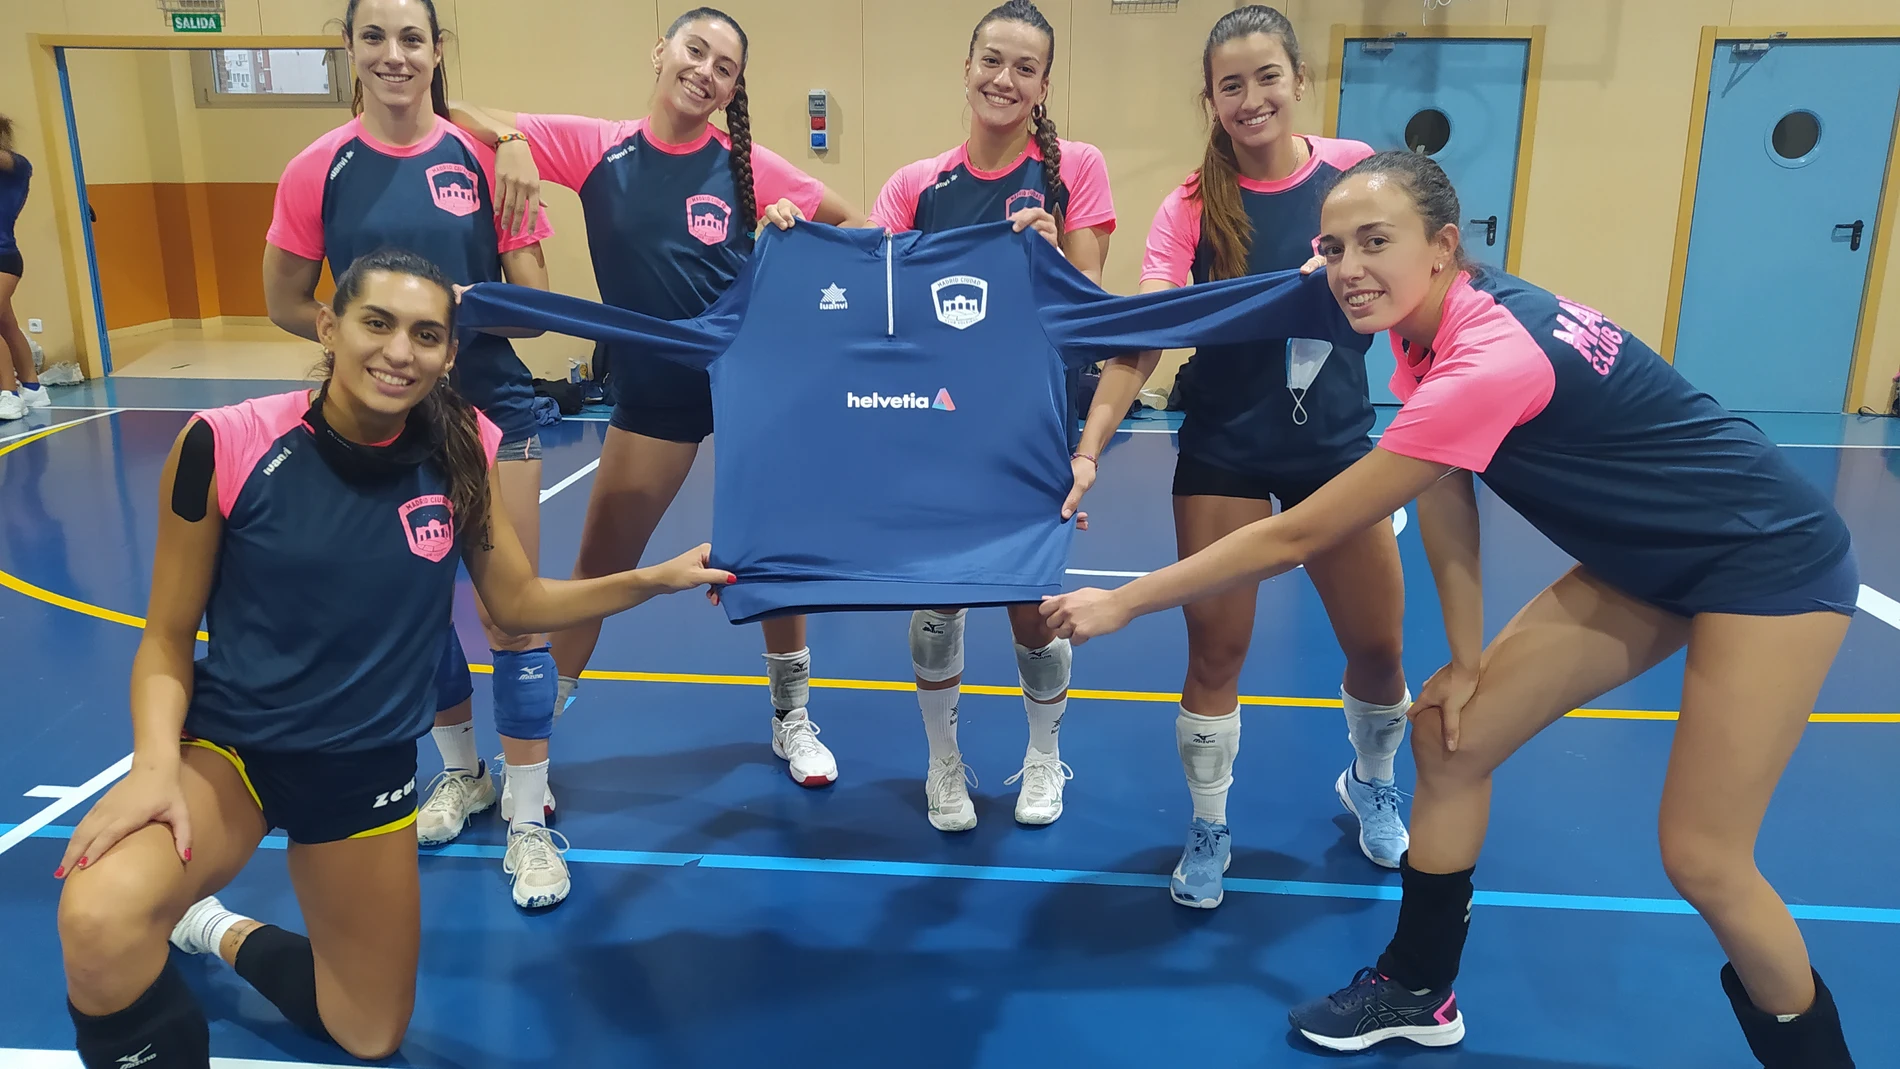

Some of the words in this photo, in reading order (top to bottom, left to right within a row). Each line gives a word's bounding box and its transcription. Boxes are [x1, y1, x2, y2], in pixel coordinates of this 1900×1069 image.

[174, 17, 217, 29] SALIDA
[937, 277, 959, 288] MADRID
[960, 277, 982, 286] CIUDAD
[819, 301, 848, 311] luanvi
[1592, 326, 1624, 376] CLUB
[847, 392, 929, 409] helvetia
[405, 496, 429, 511] MADRID
